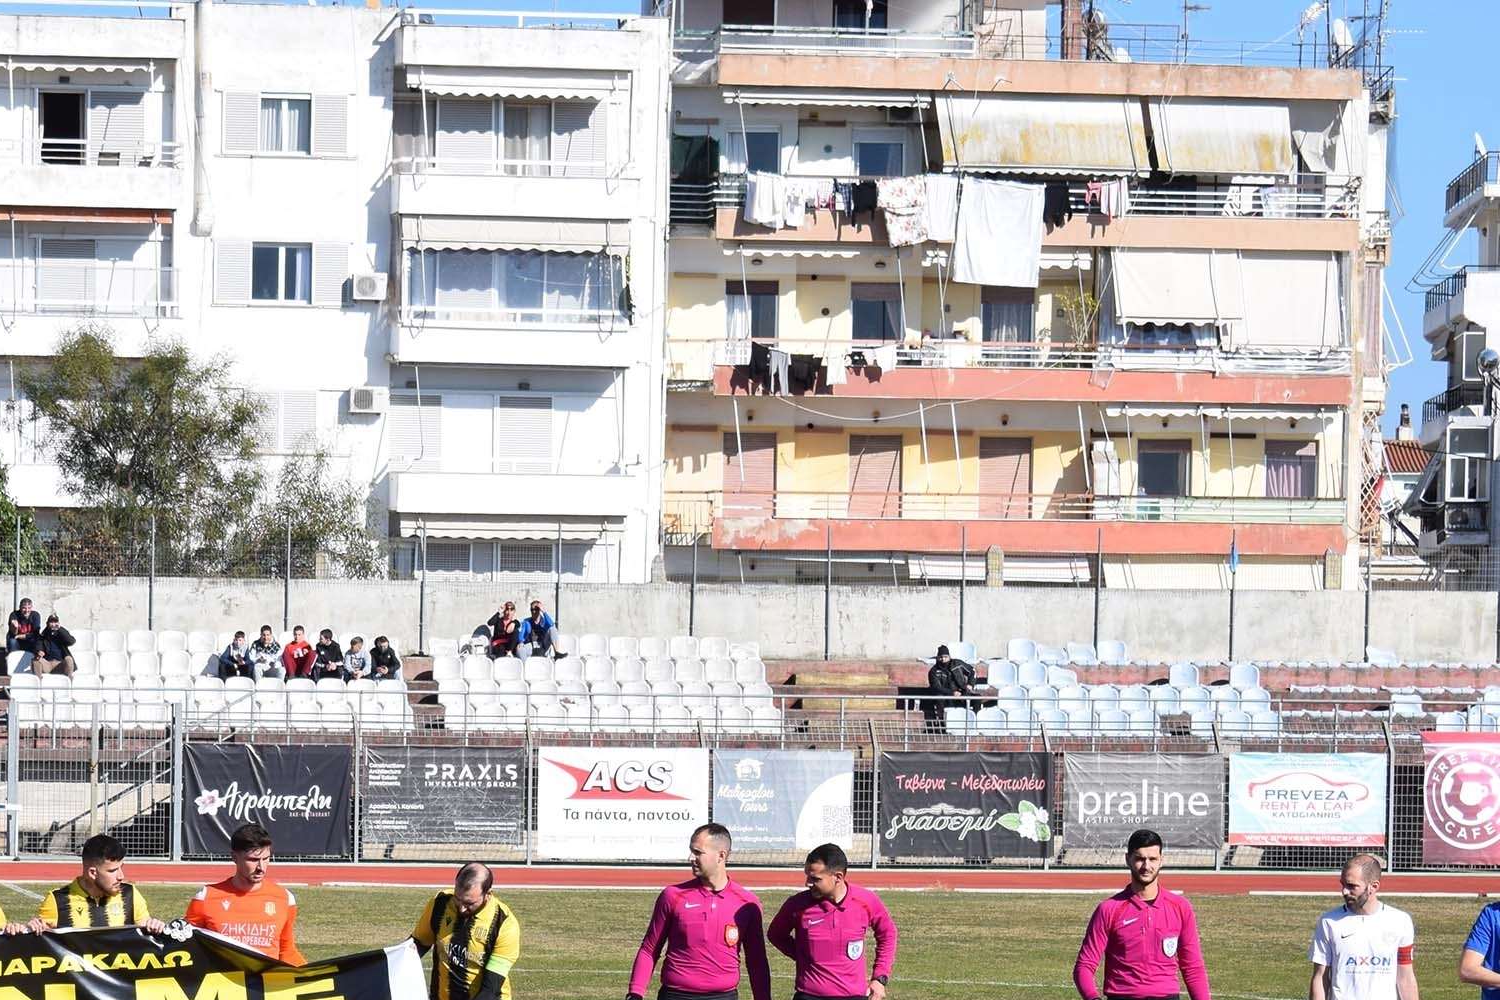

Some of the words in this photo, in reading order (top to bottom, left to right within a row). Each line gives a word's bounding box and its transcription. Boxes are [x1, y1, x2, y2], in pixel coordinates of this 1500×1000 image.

[424, 763, 518, 781] PRAXIS
[1432, 751, 1469, 783] FREE
[424, 780, 483, 788] INVESTMENT
[486, 780, 518, 788] GROUP
[580, 761, 674, 793] ACS
[895, 772, 947, 794] Ταβέρνα
[1077, 778, 1210, 824] praline
[1264, 788, 1349, 801] PREVEZA
[563, 808, 580, 820] Τα
[584, 808, 632, 822] πάντα,
[637, 808, 695, 821] παντού.
[1260, 801, 1301, 811] RENT
[1305, 801, 1317, 811] A
[1323, 801, 1354, 811] CAR
[885, 808, 999, 841] γιασεμί
[1444, 821, 1497, 840] CAFE
[220, 922, 276, 938] ΖΗΚΙΔΗΣ
[1345, 956, 1391, 966] AXON
